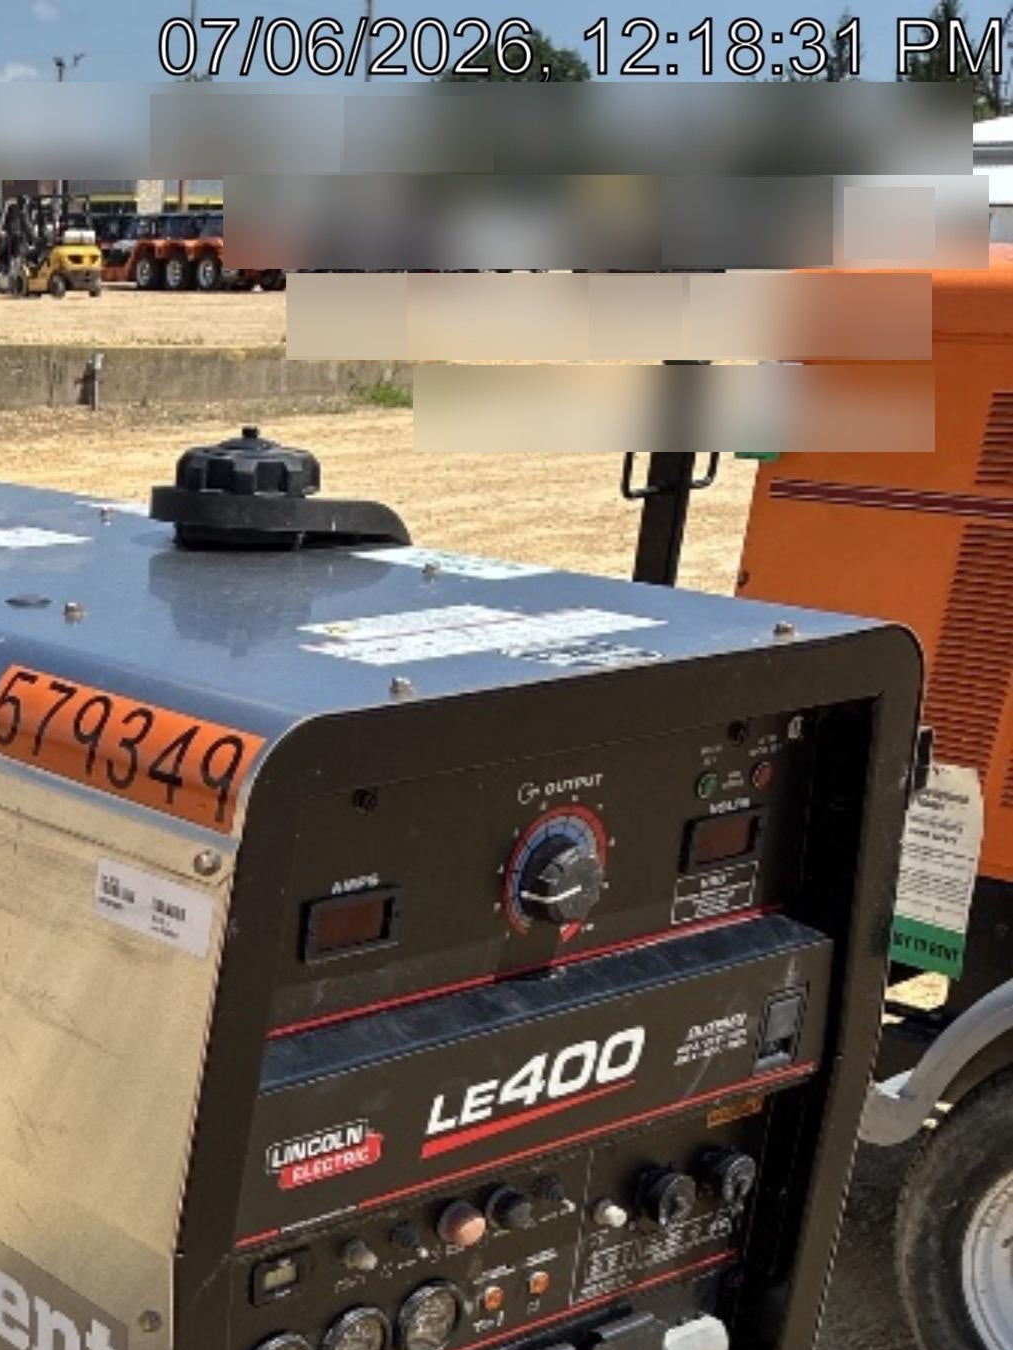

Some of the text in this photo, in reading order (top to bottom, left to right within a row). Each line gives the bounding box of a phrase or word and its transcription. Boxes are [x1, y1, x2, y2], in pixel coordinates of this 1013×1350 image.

[545, 774, 603, 796] OUTPUT
[427, 1025, 645, 1136] LE400
[272, 1124, 364, 1168] LINCOLN
[292, 1147, 369, 1184] ELECTRIC
